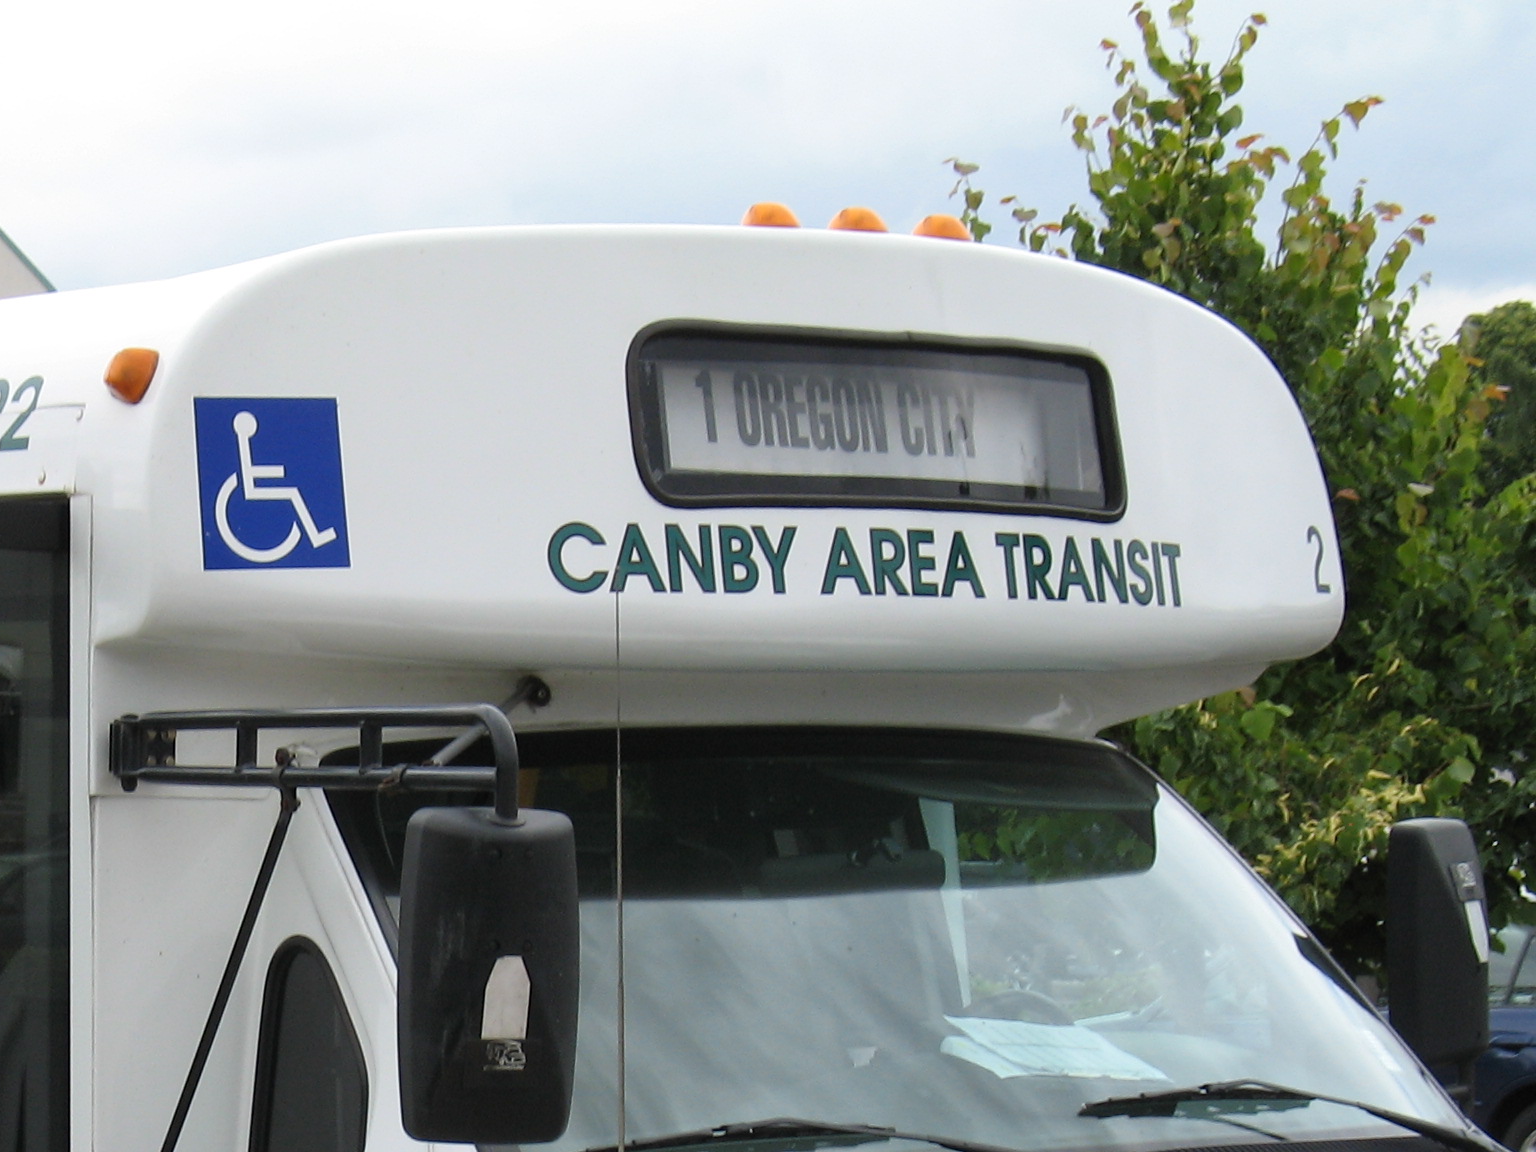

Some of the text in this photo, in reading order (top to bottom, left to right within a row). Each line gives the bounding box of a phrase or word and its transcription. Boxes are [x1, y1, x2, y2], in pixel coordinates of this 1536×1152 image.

[694, 367, 977, 459] 1 OREGON CITY
[547, 521, 1182, 608] CANBY AREA TRANSIT
[1306, 524, 1332, 595] 2
